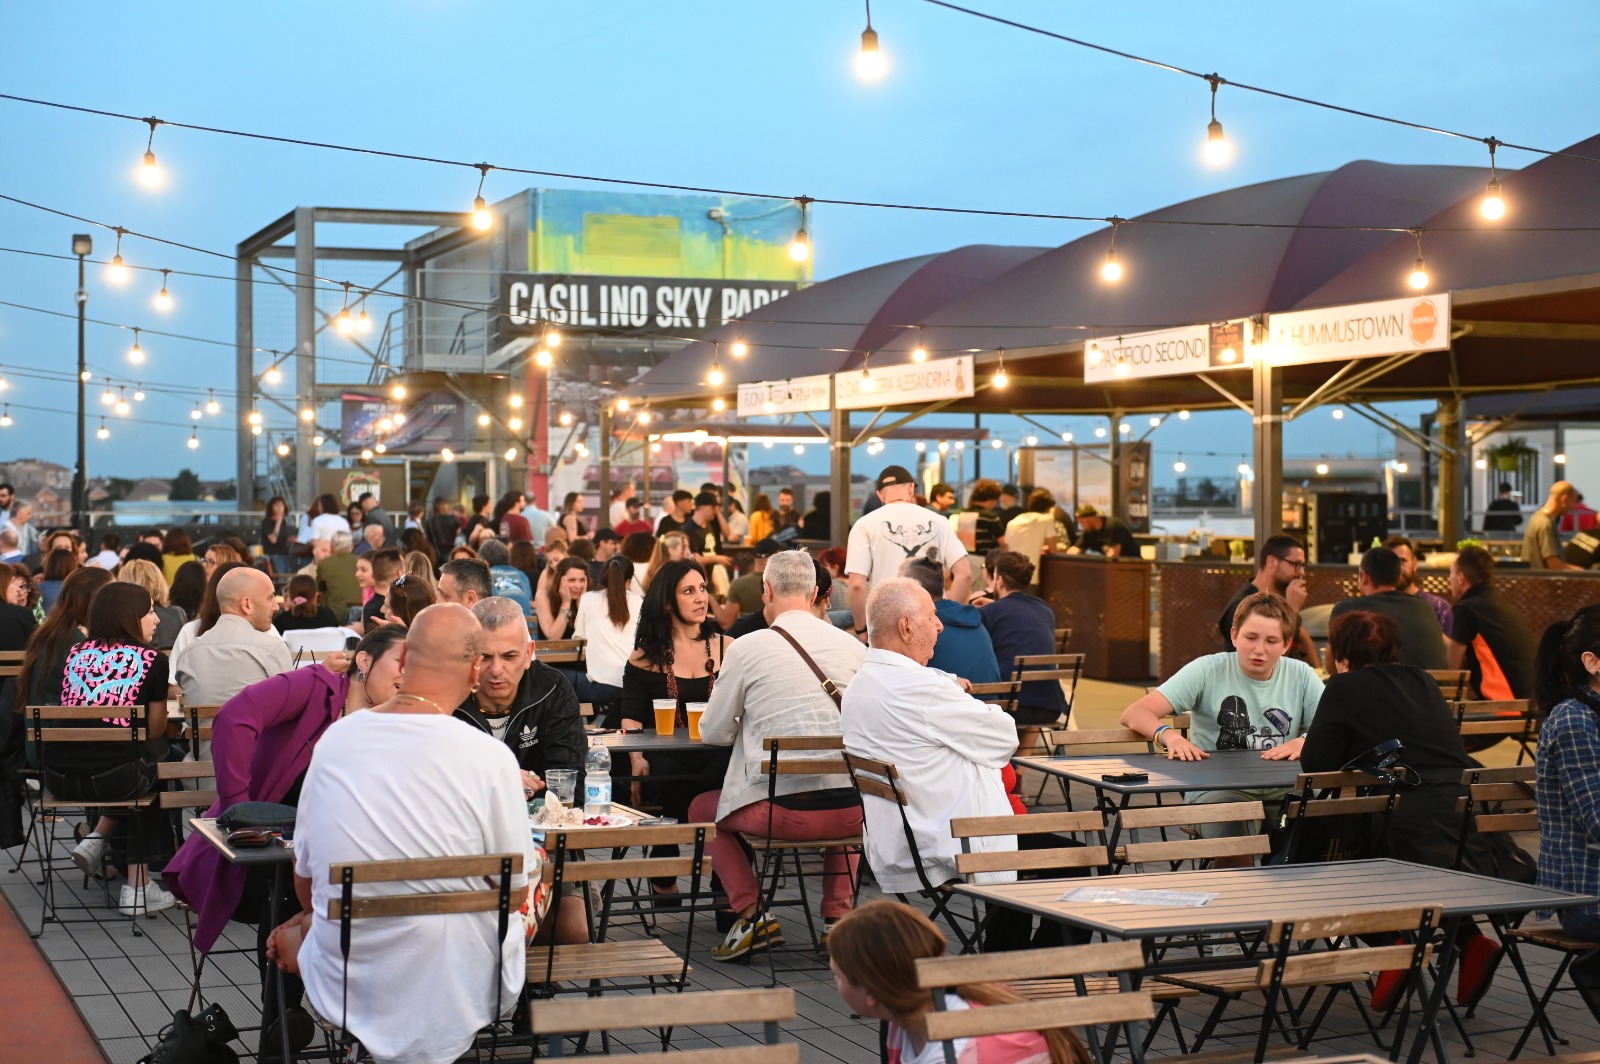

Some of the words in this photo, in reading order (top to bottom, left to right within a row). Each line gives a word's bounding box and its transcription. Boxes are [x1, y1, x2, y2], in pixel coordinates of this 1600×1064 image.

[509, 281, 649, 327] CASILINO
[655, 285, 713, 328] SKY
[1291, 313, 1404, 346] HUMMUSTOWN
[1155, 337, 1206, 363] SECONDI
[518, 738, 539, 749] adidas
